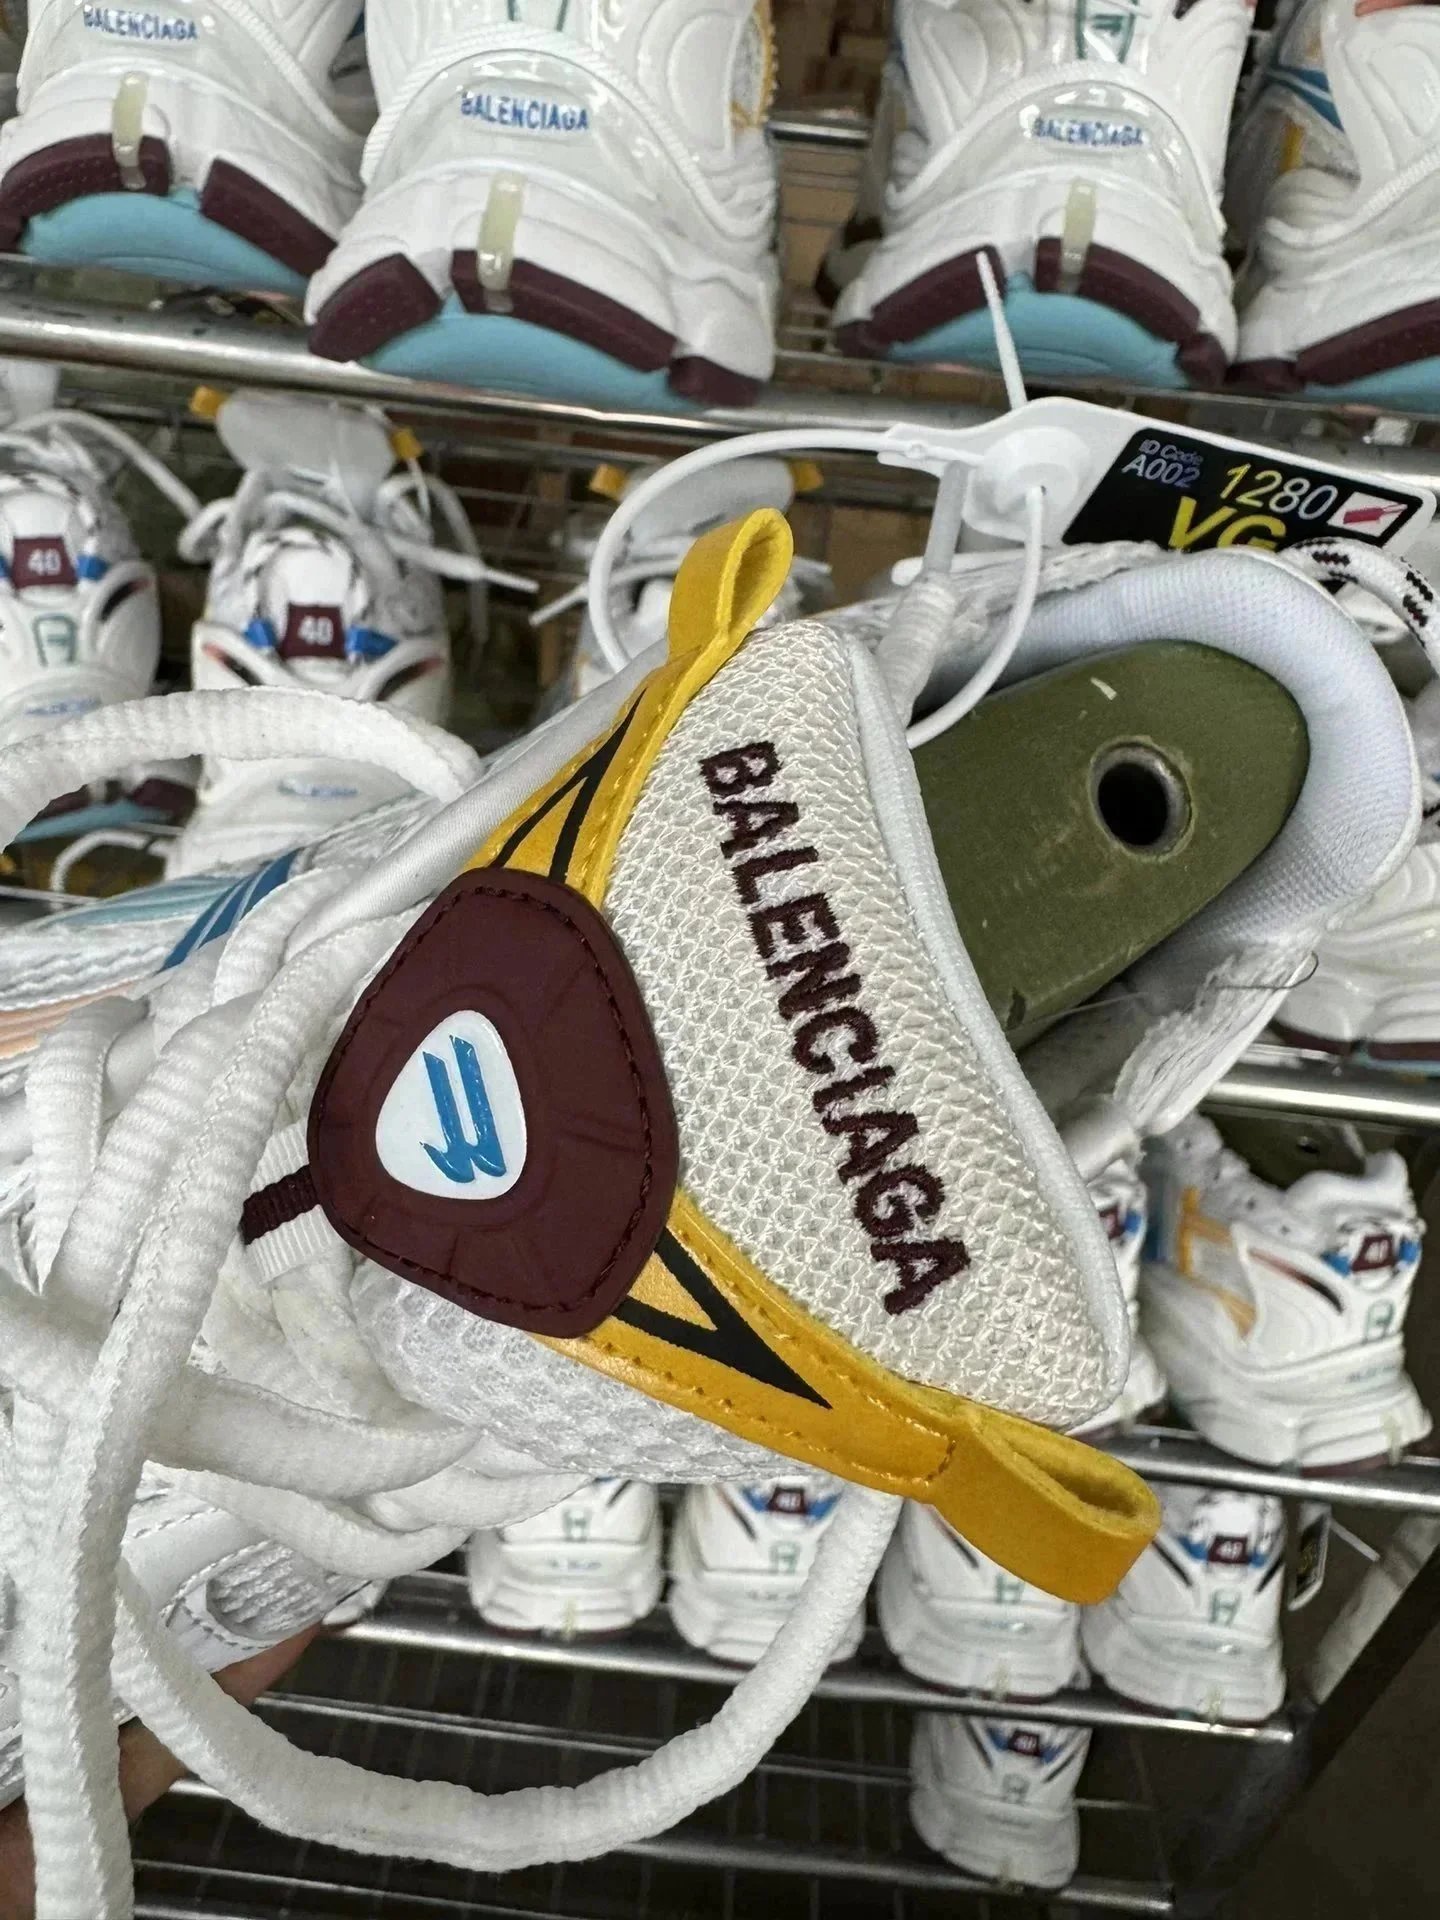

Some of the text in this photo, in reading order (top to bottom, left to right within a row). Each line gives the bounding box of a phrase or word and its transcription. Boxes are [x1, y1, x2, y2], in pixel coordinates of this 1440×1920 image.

[82, 7, 199, 41] BALENCIAGA
[461, 91, 590, 131] BALENCIAGA
[1121, 453, 1201, 488] A002
[1220, 463, 1338, 520] 1280
[27, 548, 62, 576] 40
[298, 615, 334, 646] 40
[700, 740, 971, 1317] BALENCIAGA
